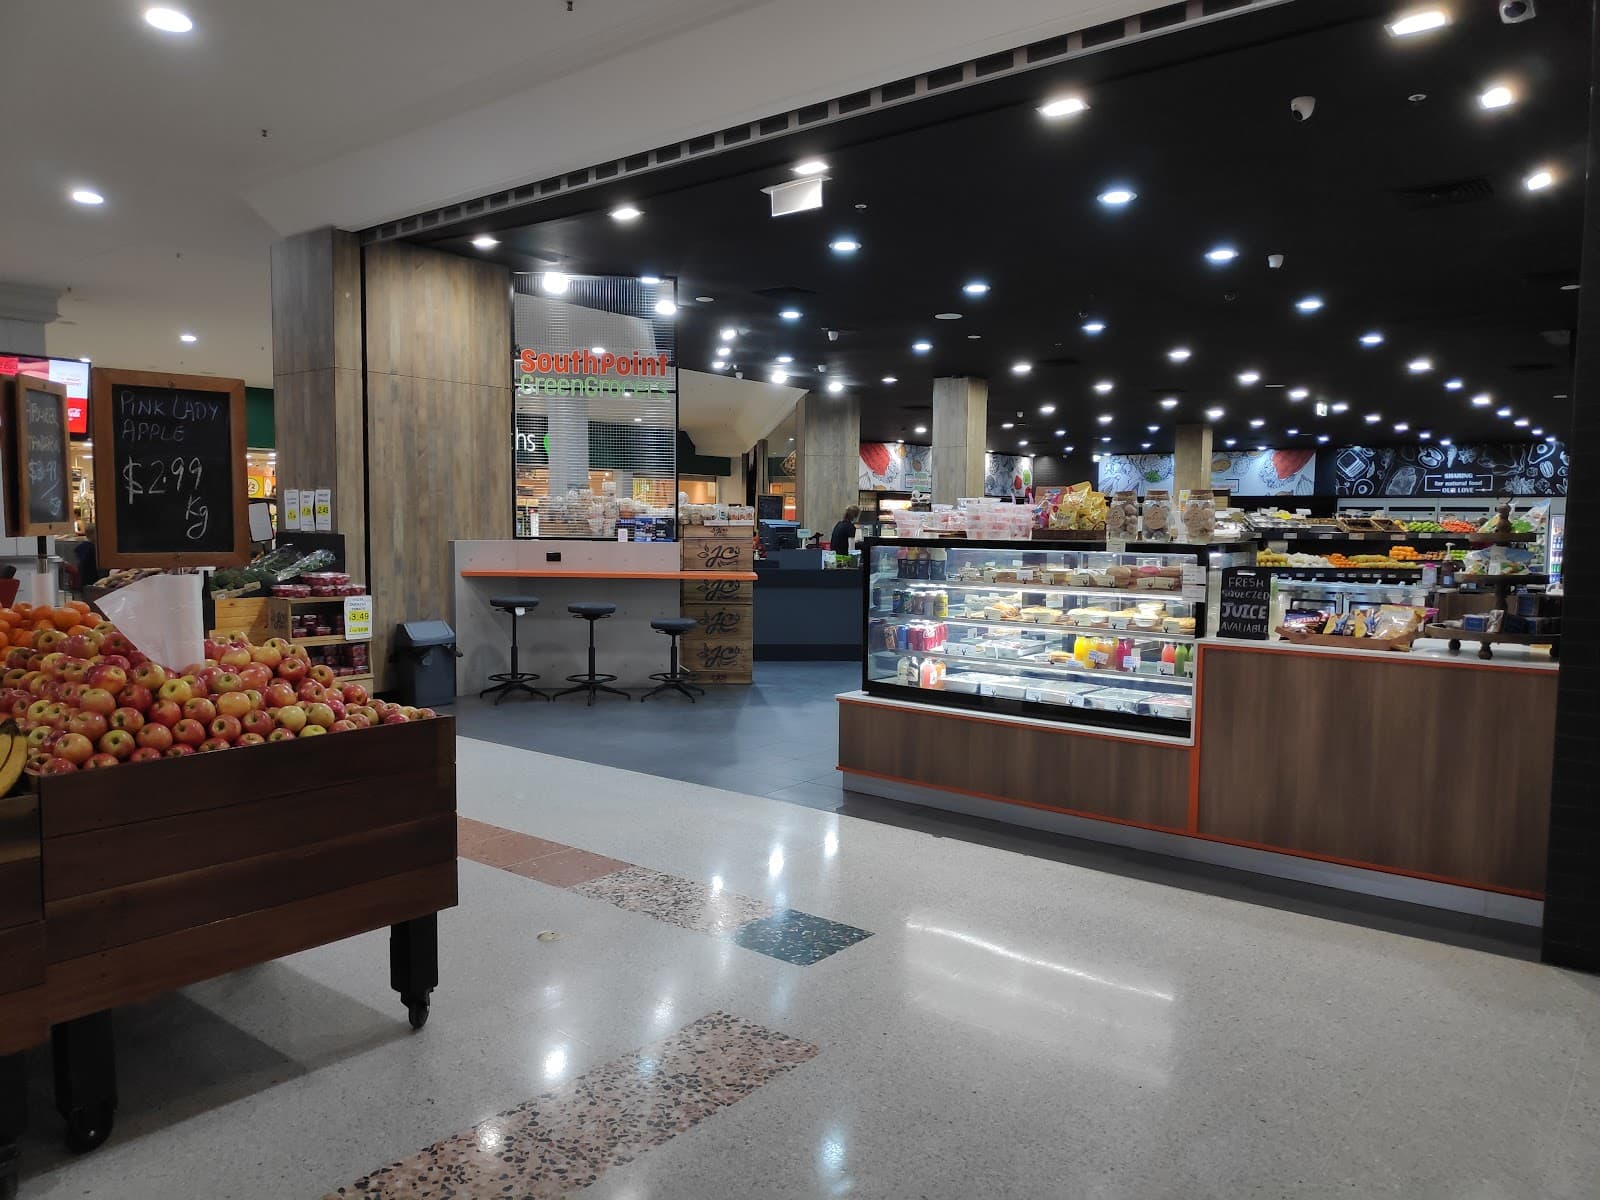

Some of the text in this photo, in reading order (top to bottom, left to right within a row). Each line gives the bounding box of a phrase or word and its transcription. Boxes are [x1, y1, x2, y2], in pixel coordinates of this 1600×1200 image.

[520, 348, 668, 377] SouthPoint
[520, 374, 669, 399] GreenGrocers
[173, 394, 220, 421] LADY
[122, 420, 185, 442] APPLE
[123, 456, 203, 505] $2.99
[1228, 577, 1264, 588] FRESH
[1221, 602, 1267, 619] JUICE
